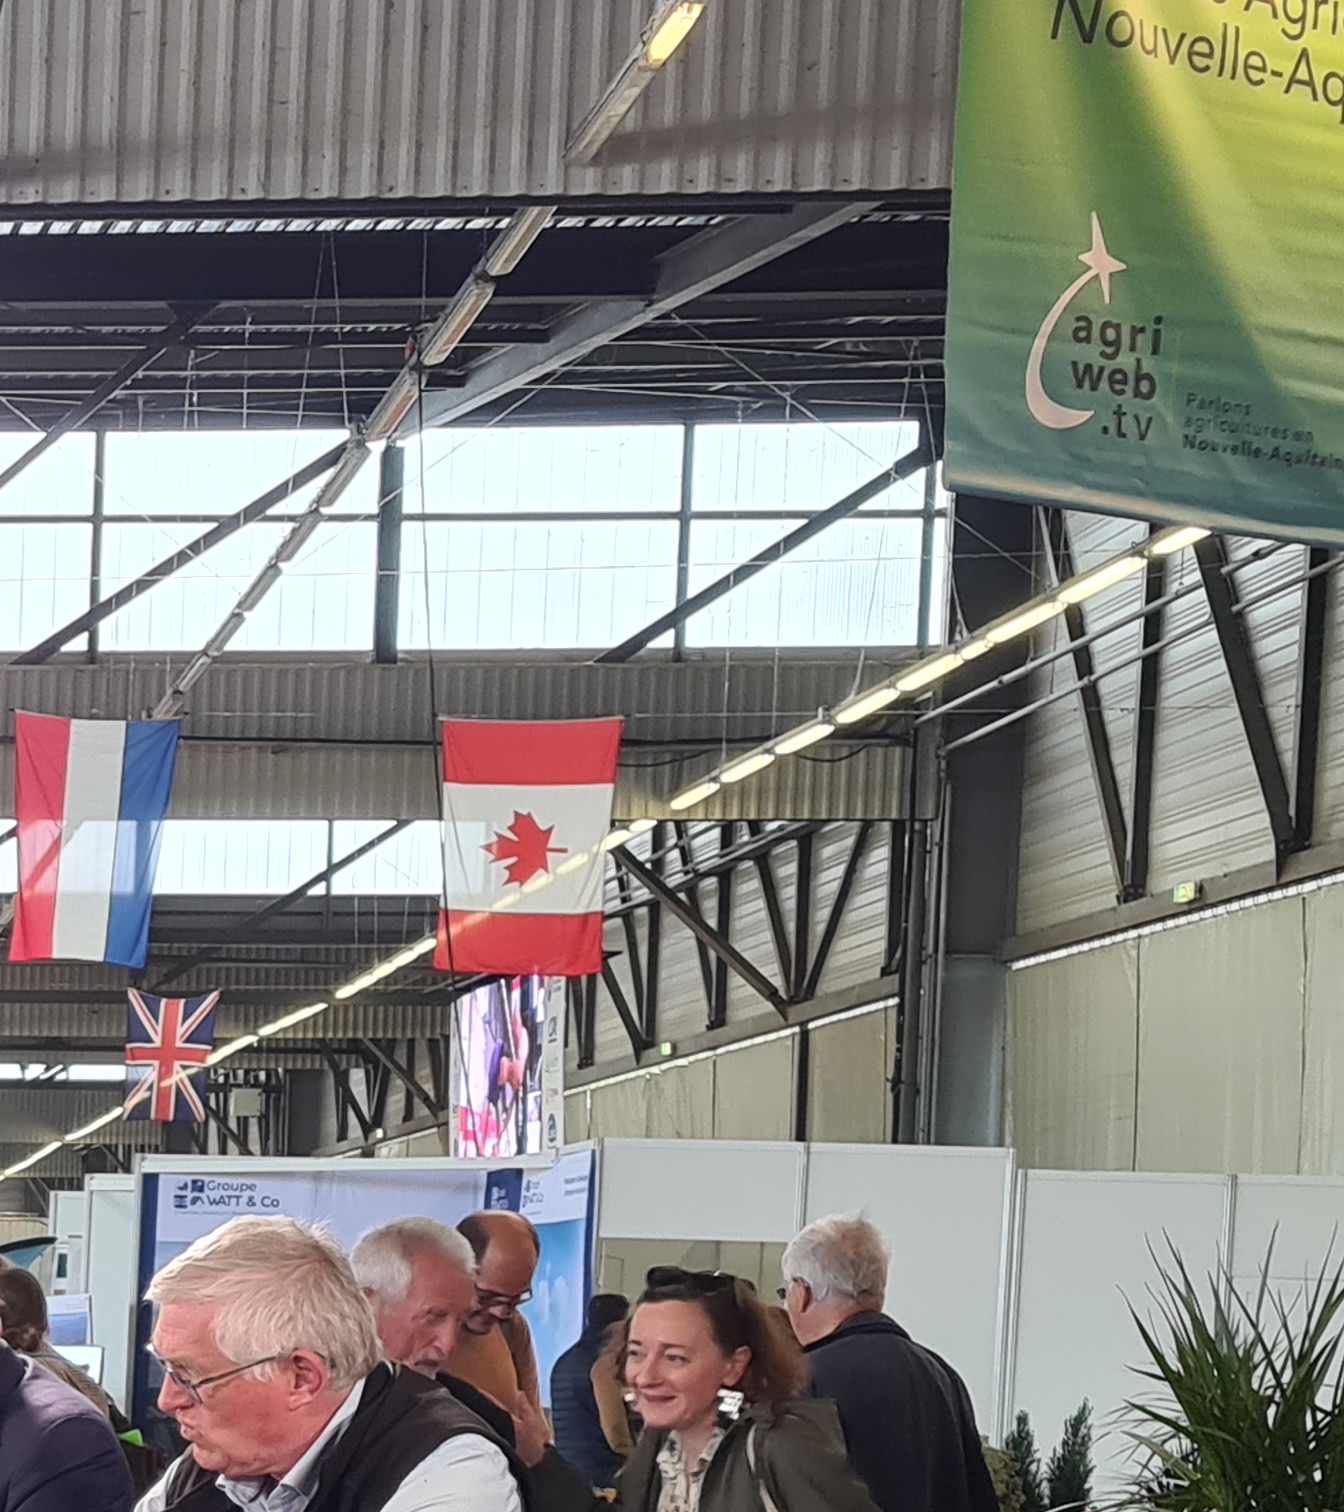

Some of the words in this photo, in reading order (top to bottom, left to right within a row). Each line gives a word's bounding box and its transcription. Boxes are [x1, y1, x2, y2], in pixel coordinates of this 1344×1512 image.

[1050, 0, 1344, 126] Nouvelle-Aq
[1072, 314, 1164, 361] agri
[1071, 356, 1157, 401] web
[1101, 403, 1153, 441] .tv
[1185, 392, 1252, 417] Parlons
[1184, 413, 1289, 442] agricultures
[1182, 433, 1344, 472] Nouvelle-Aquitain
[206, 1180, 258, 1193] Groupe
[207, 1195, 243, 1207] WATT
[246, 1196, 257, 1207] &
[260, 1195, 281, 1208] Co
